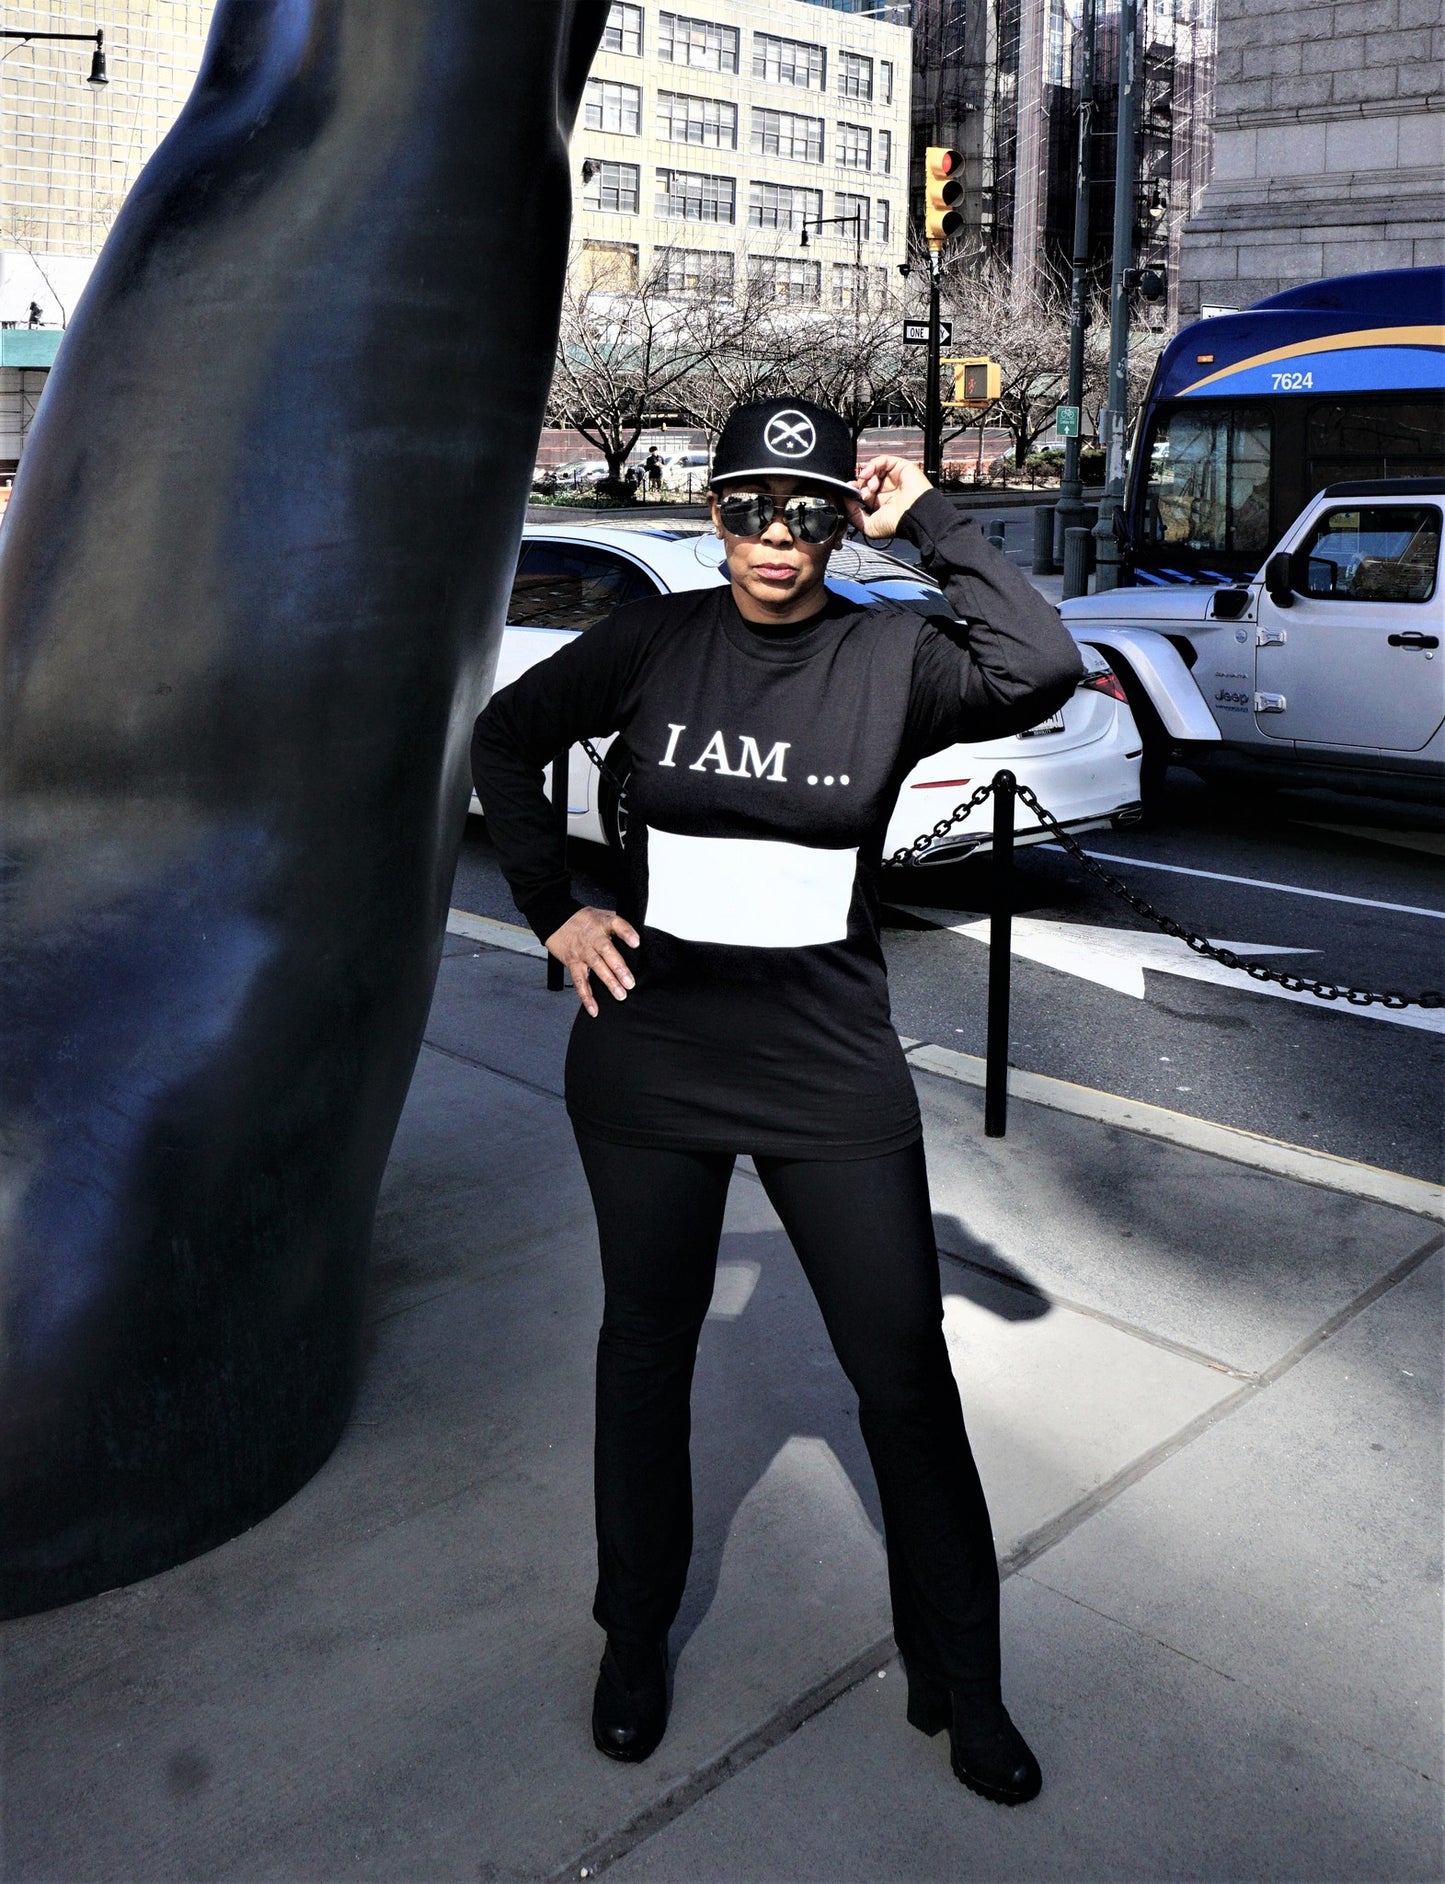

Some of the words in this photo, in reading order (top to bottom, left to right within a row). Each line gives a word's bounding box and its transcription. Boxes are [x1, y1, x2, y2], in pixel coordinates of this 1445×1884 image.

[910, 327, 925, 338] ONE
[1271, 371, 1314, 390] 7624
[1215, 689, 1249, 706] Jeep
[658, 723, 686, 767] I
